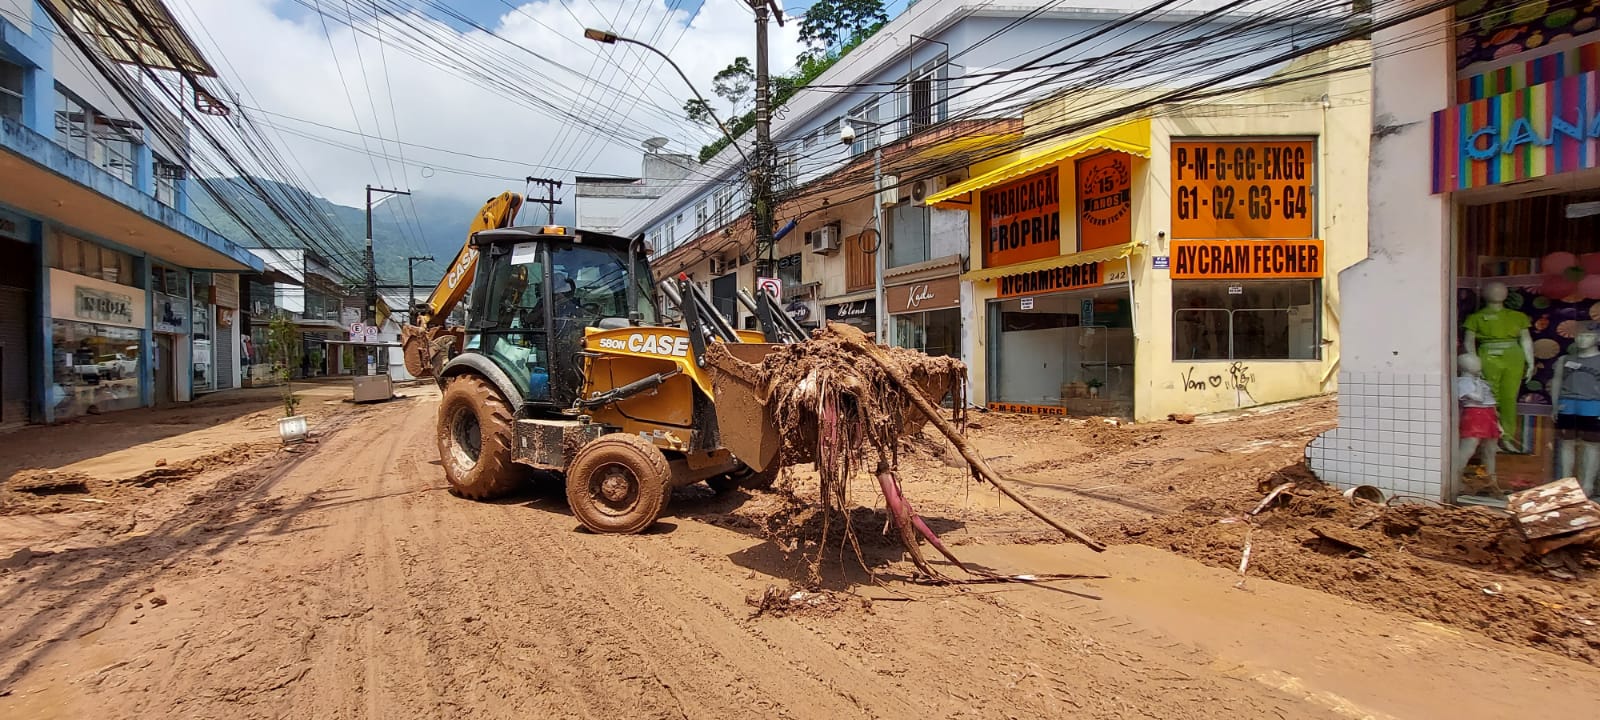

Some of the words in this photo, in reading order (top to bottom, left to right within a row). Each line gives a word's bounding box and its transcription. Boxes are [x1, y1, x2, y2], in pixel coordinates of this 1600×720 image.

[1097, 175, 1114, 193] 15
[989, 212, 1060, 253] PRÓPRIA
[447, 245, 480, 290] CASE
[1176, 245, 1250, 274] AYCRAM
[1253, 245, 1319, 274] FECHER
[1110, 271, 1126, 281] 242
[600, 338, 626, 350] 580N
[628, 333, 690, 357] CASE
